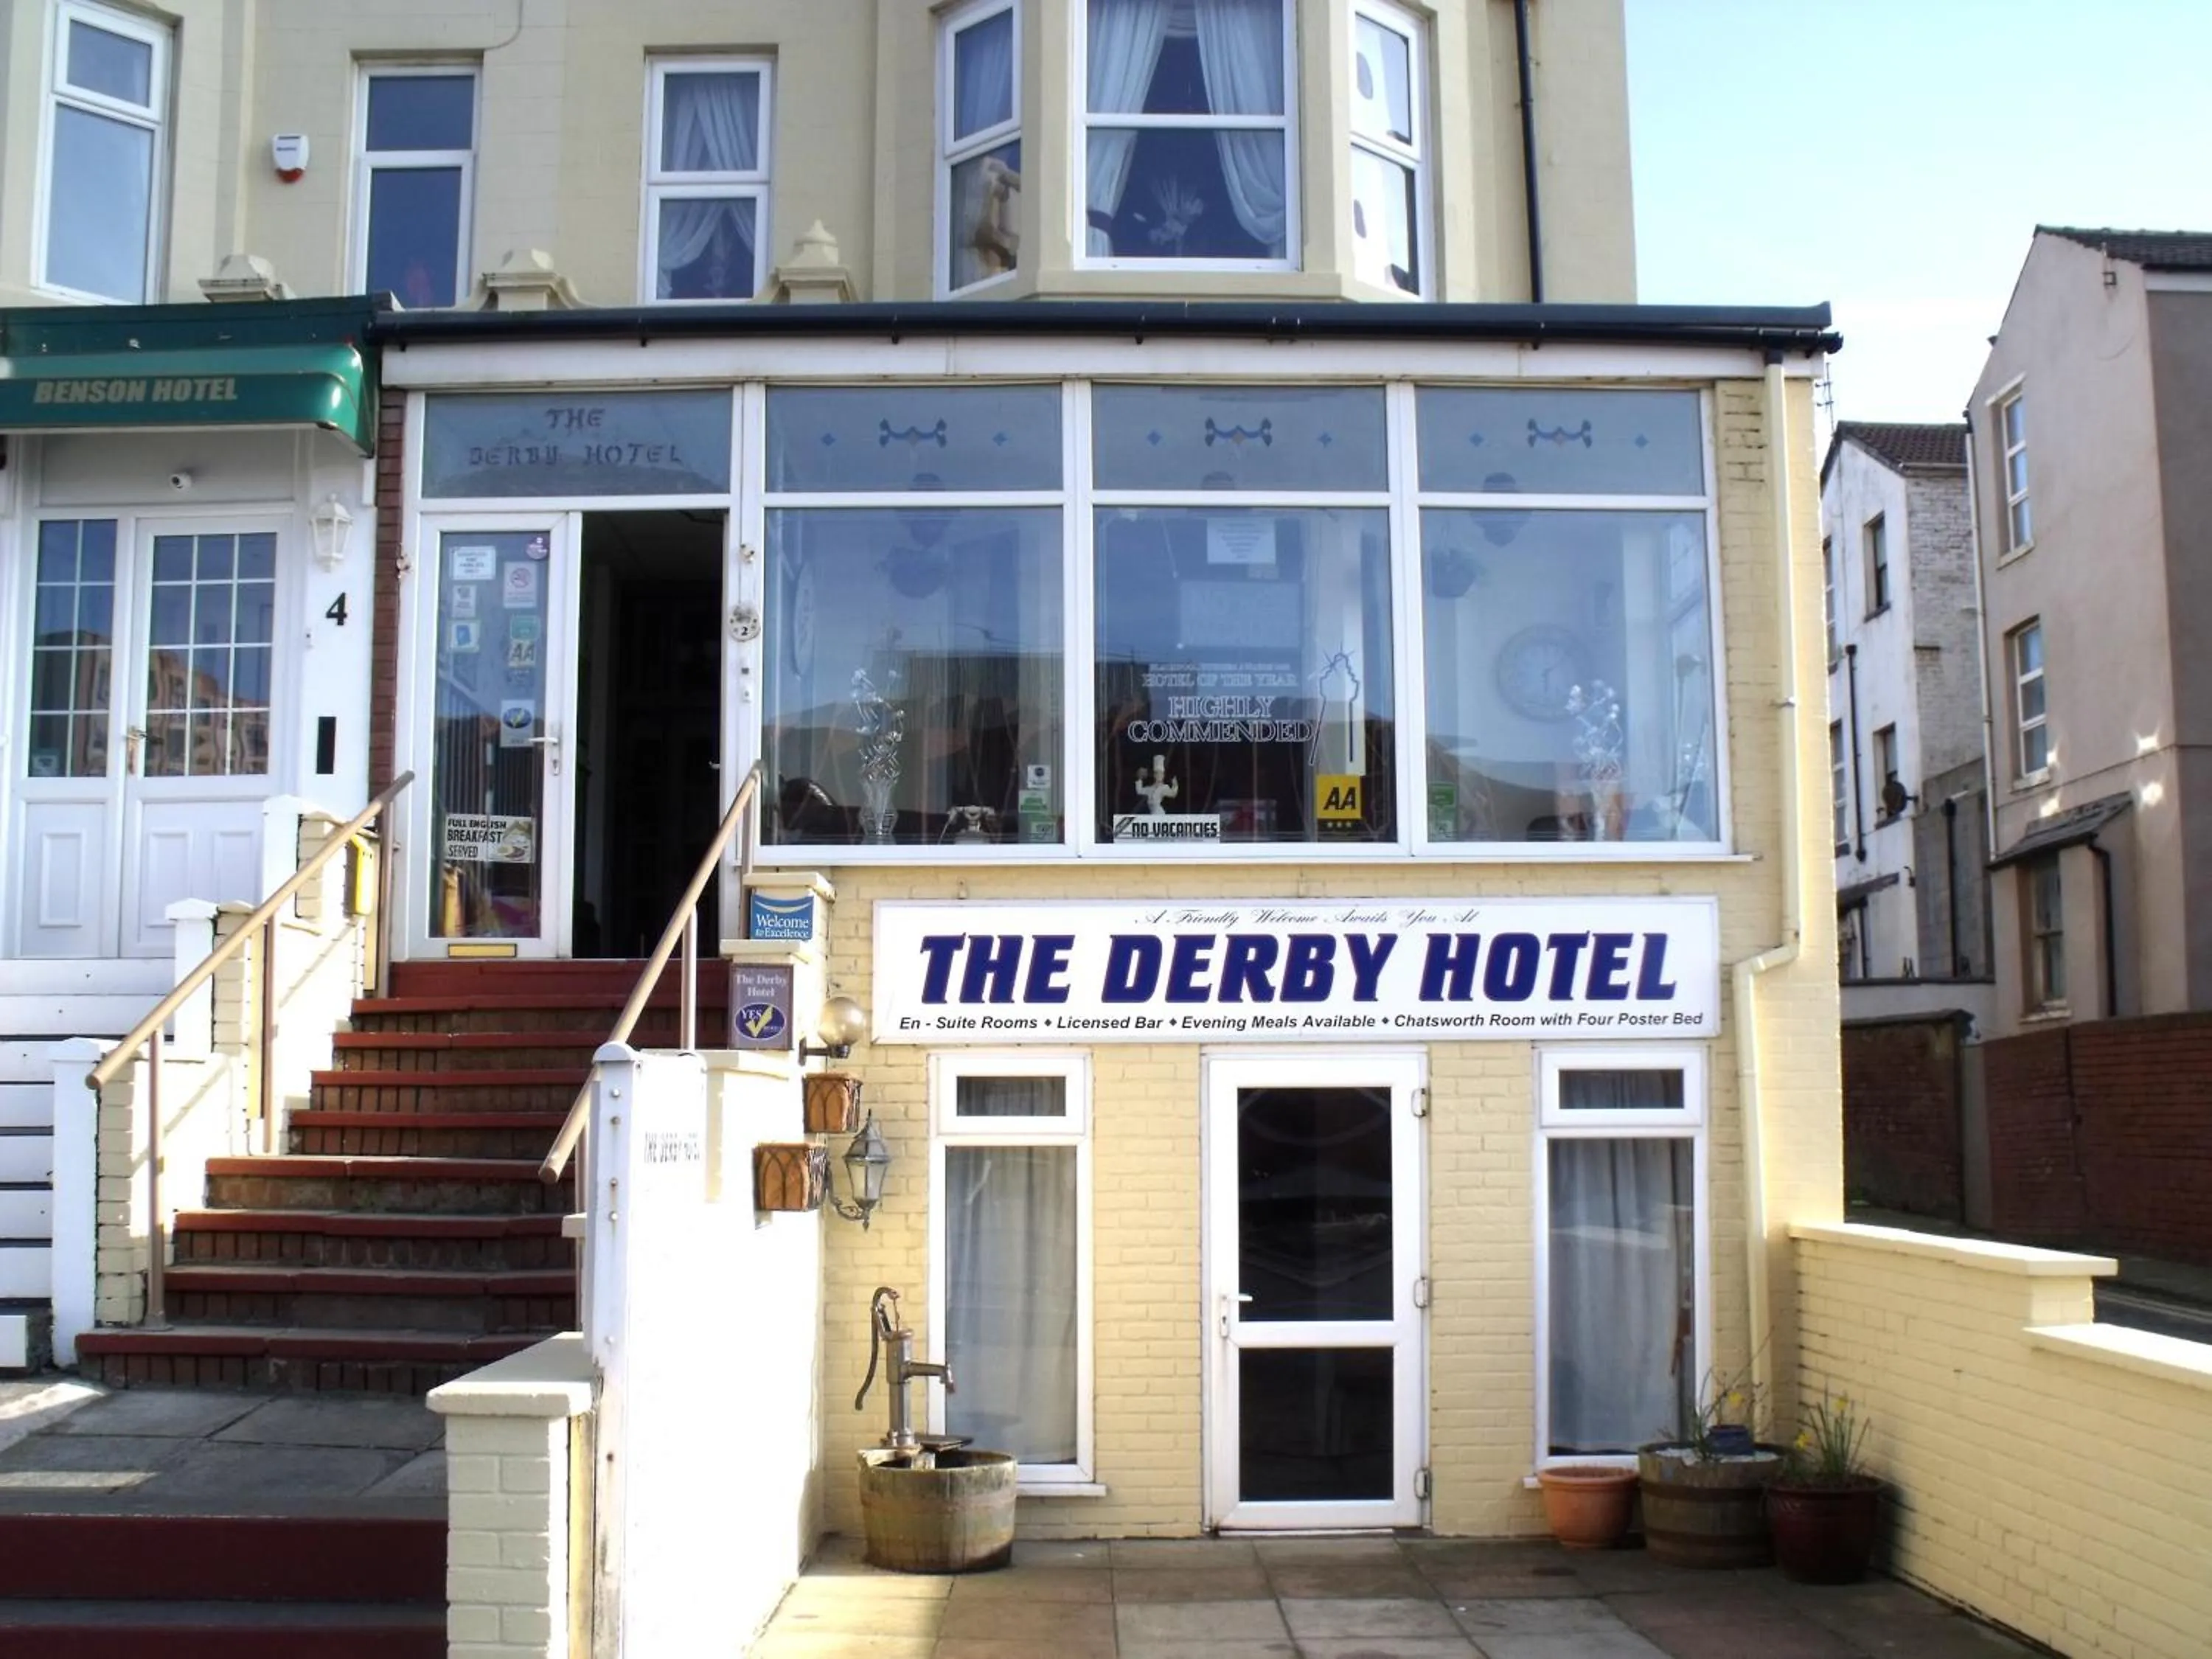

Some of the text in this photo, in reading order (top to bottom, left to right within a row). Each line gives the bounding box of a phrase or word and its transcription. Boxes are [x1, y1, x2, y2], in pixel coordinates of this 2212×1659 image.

[34, 378, 237, 404] BENSON HOTEL
[544, 407, 606, 431] THE
[469, 442, 683, 466] DERBY HOTEL
[325, 592, 347, 626] 4
[511, 642, 535, 661] AA
[1168, 696, 1275, 719] HIGHLY
[1127, 720, 1315, 742] COMMENDED
[1324, 787, 1357, 810] AA
[448, 818, 467, 827] FULL
[1152, 821, 1218, 838] VACANCIES
[447, 829, 504, 844] BREAKFAST
[448, 844, 479, 858] SERVED
[755, 914, 809, 929] Welcome
[1166, 909, 1239, 929] Friendly
[1250, 908, 1318, 924] Welcome
[1324, 908, 1388, 924] Awaits
[1400, 908, 1436, 928] You
[755, 928, 809, 939] to Excellence
[920, 930, 1677, 1004] THE DERBY HOTEL
[736, 973, 787, 987] The Derby
[747, 986, 776, 997] Hotel
[740, 1009, 762, 1020] YES
[900, 1017, 920, 1029] En
[936, 1016, 976, 1029] Suite
[981, 1016, 1038, 1029] Rooms
[1057, 1016, 1130, 1029] Licensed
[1135, 1016, 1163, 1029] Bar
[1182, 1015, 1247, 1032] Evening
[1251, 1015, 1298, 1028] Meals
[1302, 1014, 1376, 1028] Available
[1394, 1013, 1484, 1027] Chatsworth
[1489, 1014, 1535, 1026] Room
[1540, 1013, 1572, 1026] with
[1577, 1012, 1614, 1026] Four
[1618, 1012, 1669, 1026] Poster
[1672, 1012, 1703, 1026] Bed
